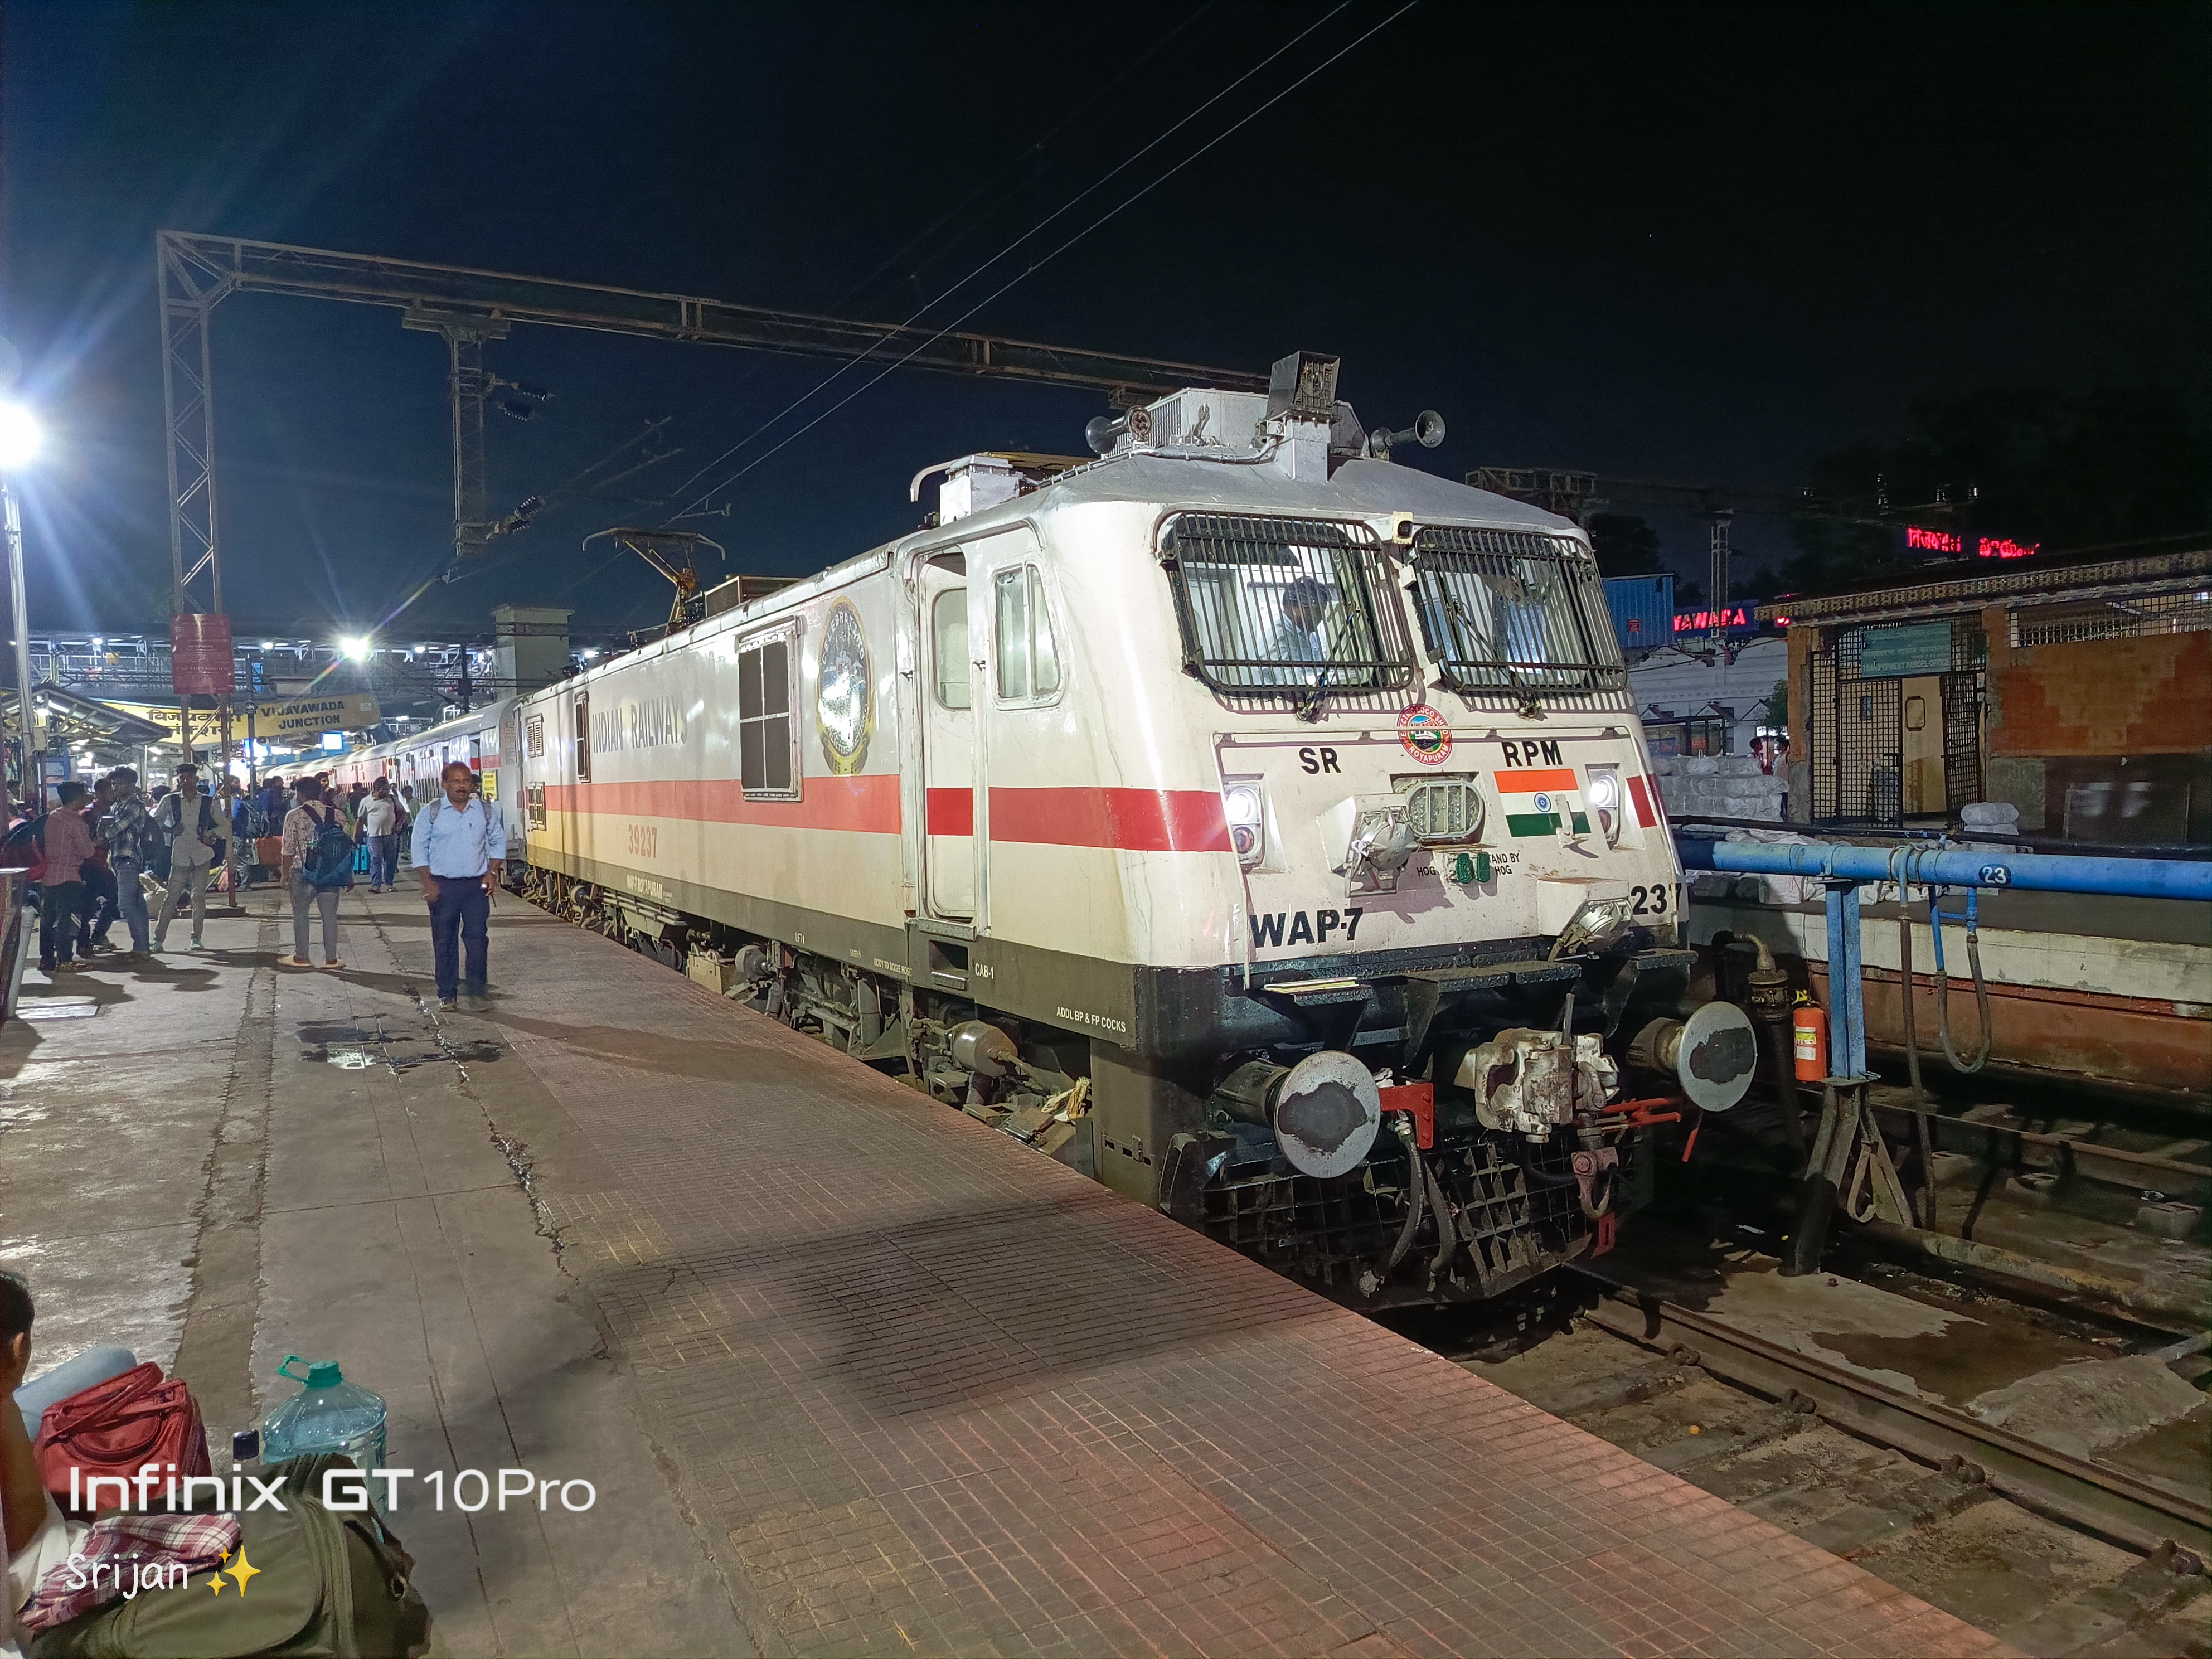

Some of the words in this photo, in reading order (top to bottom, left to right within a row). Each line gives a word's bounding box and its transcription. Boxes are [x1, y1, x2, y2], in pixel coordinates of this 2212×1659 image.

[822, 611, 865, 665] CELEBRATING
[261, 700, 345, 717] VIJAYAWADA
[1416, 706, 1435, 717] LOCO
[278, 714, 341, 730] JUNCTION
[592, 707, 624, 754] INDIAN
[630, 695, 688, 749] RAILWAYS
[1299, 746, 1342, 775] SR
[1408, 744, 1449, 763] ROYAPURAM
[1501, 740, 1564, 768] RPM
[628, 823, 658, 858] 39237
[1510, 852, 1520, 863] BY
[1417, 866, 1437, 877] HOG
[1495, 865, 1513, 875] HOG
[1982, 866, 2006, 884] 23
[1250, 907, 1364, 948] WAP-7
[874, 957, 884, 968] BODY
[884, 960, 889, 969] TO
[890, 962, 901, 973] BOGIE
[975, 963, 995, 979] CAB-1
[1056, 1006, 1074, 1020] ADDL
[1074, 1010, 1084, 1022] BP
[1085, 1013, 1090, 1023] &
[1091, 1014, 1100, 1026] FP
[1101, 1017, 1126, 1032] COCKS
